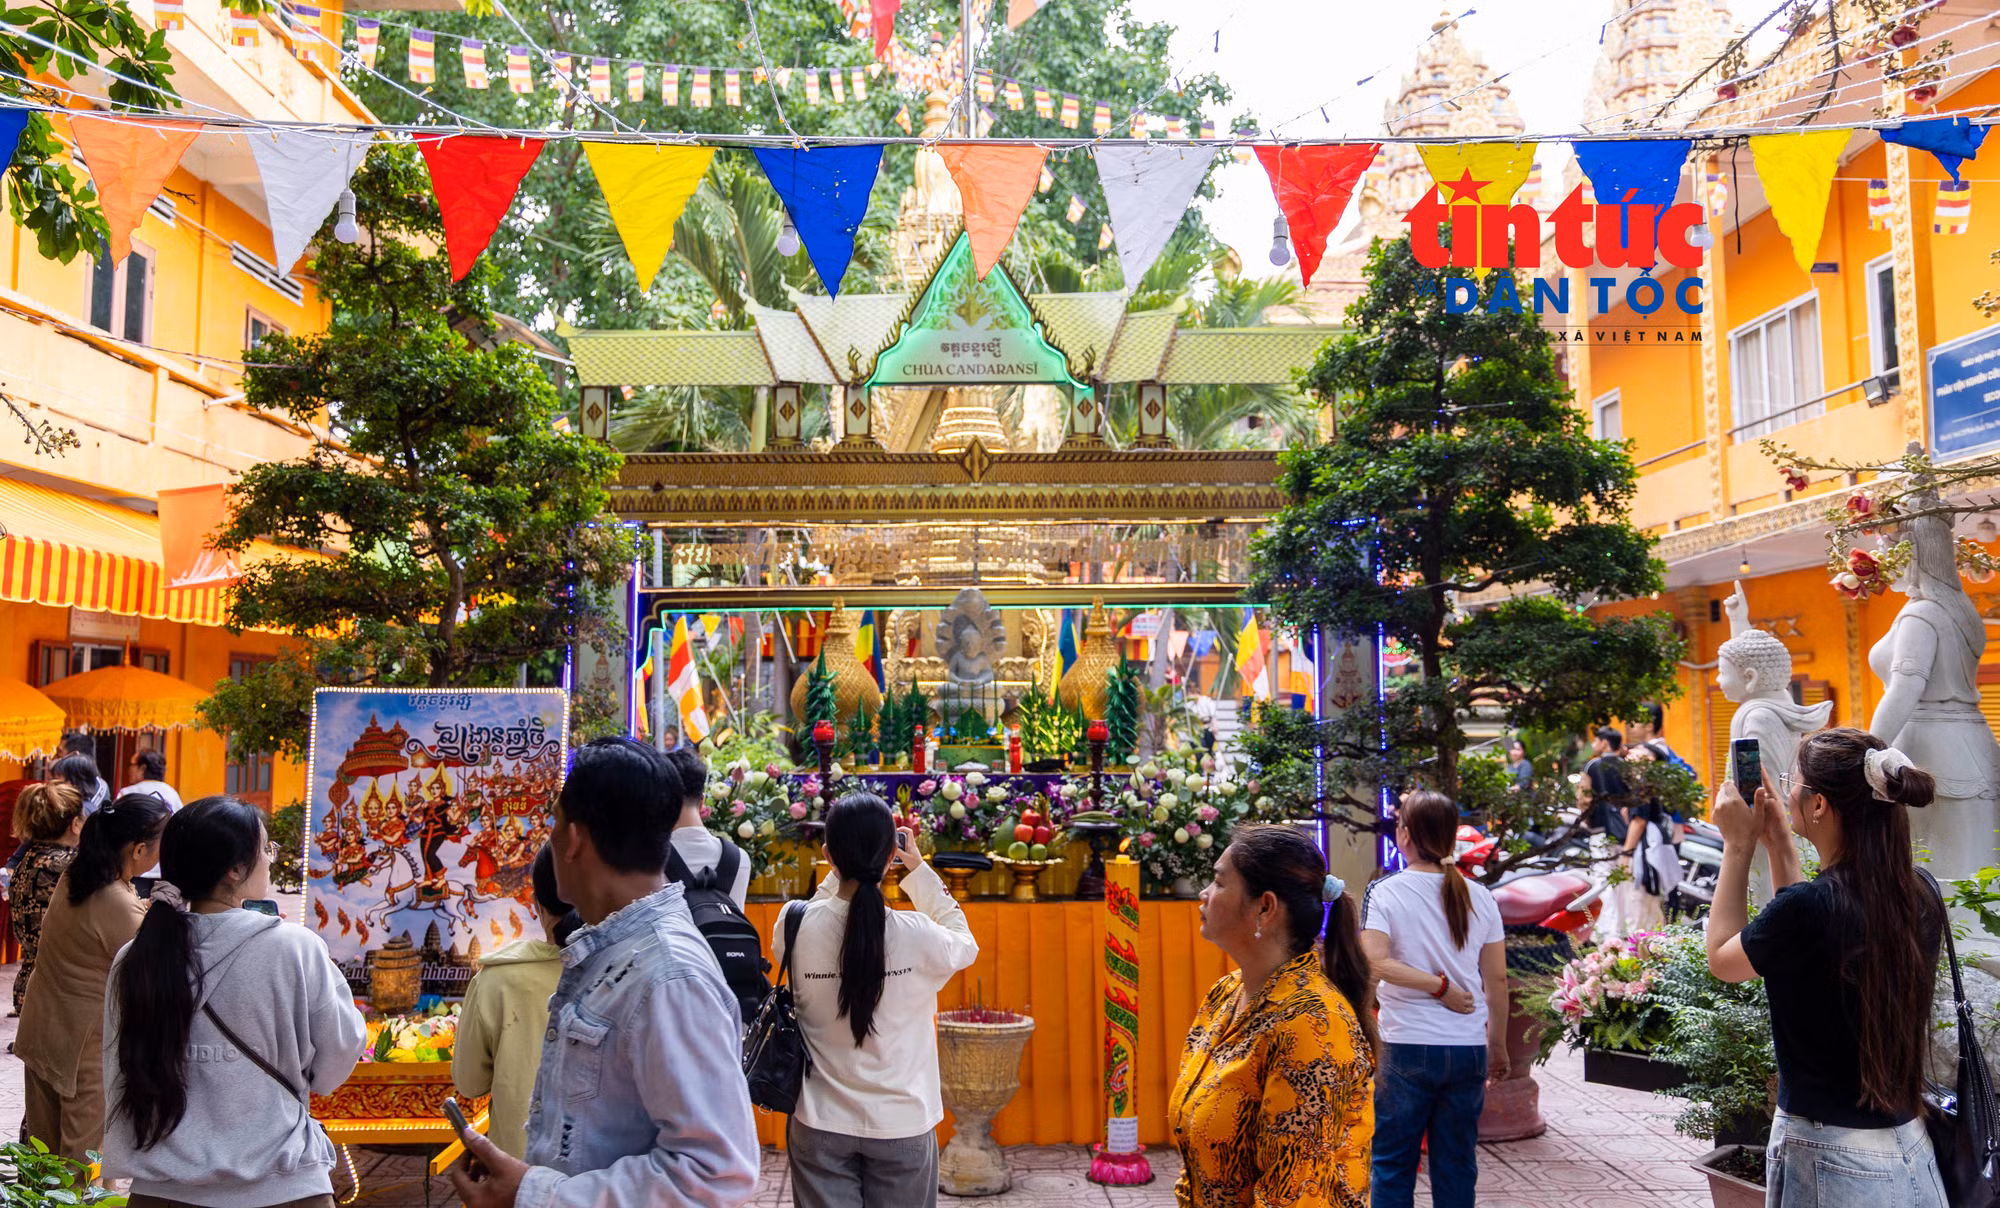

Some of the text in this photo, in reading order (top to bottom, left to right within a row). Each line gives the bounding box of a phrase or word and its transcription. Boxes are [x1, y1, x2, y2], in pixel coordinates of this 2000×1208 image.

[902, 361, 944, 376] CHÙA
[421, 961, 472, 980] hhnam
[804, 971, 842, 980] Winnie.
[186, 1044, 241, 1063] UDIO
